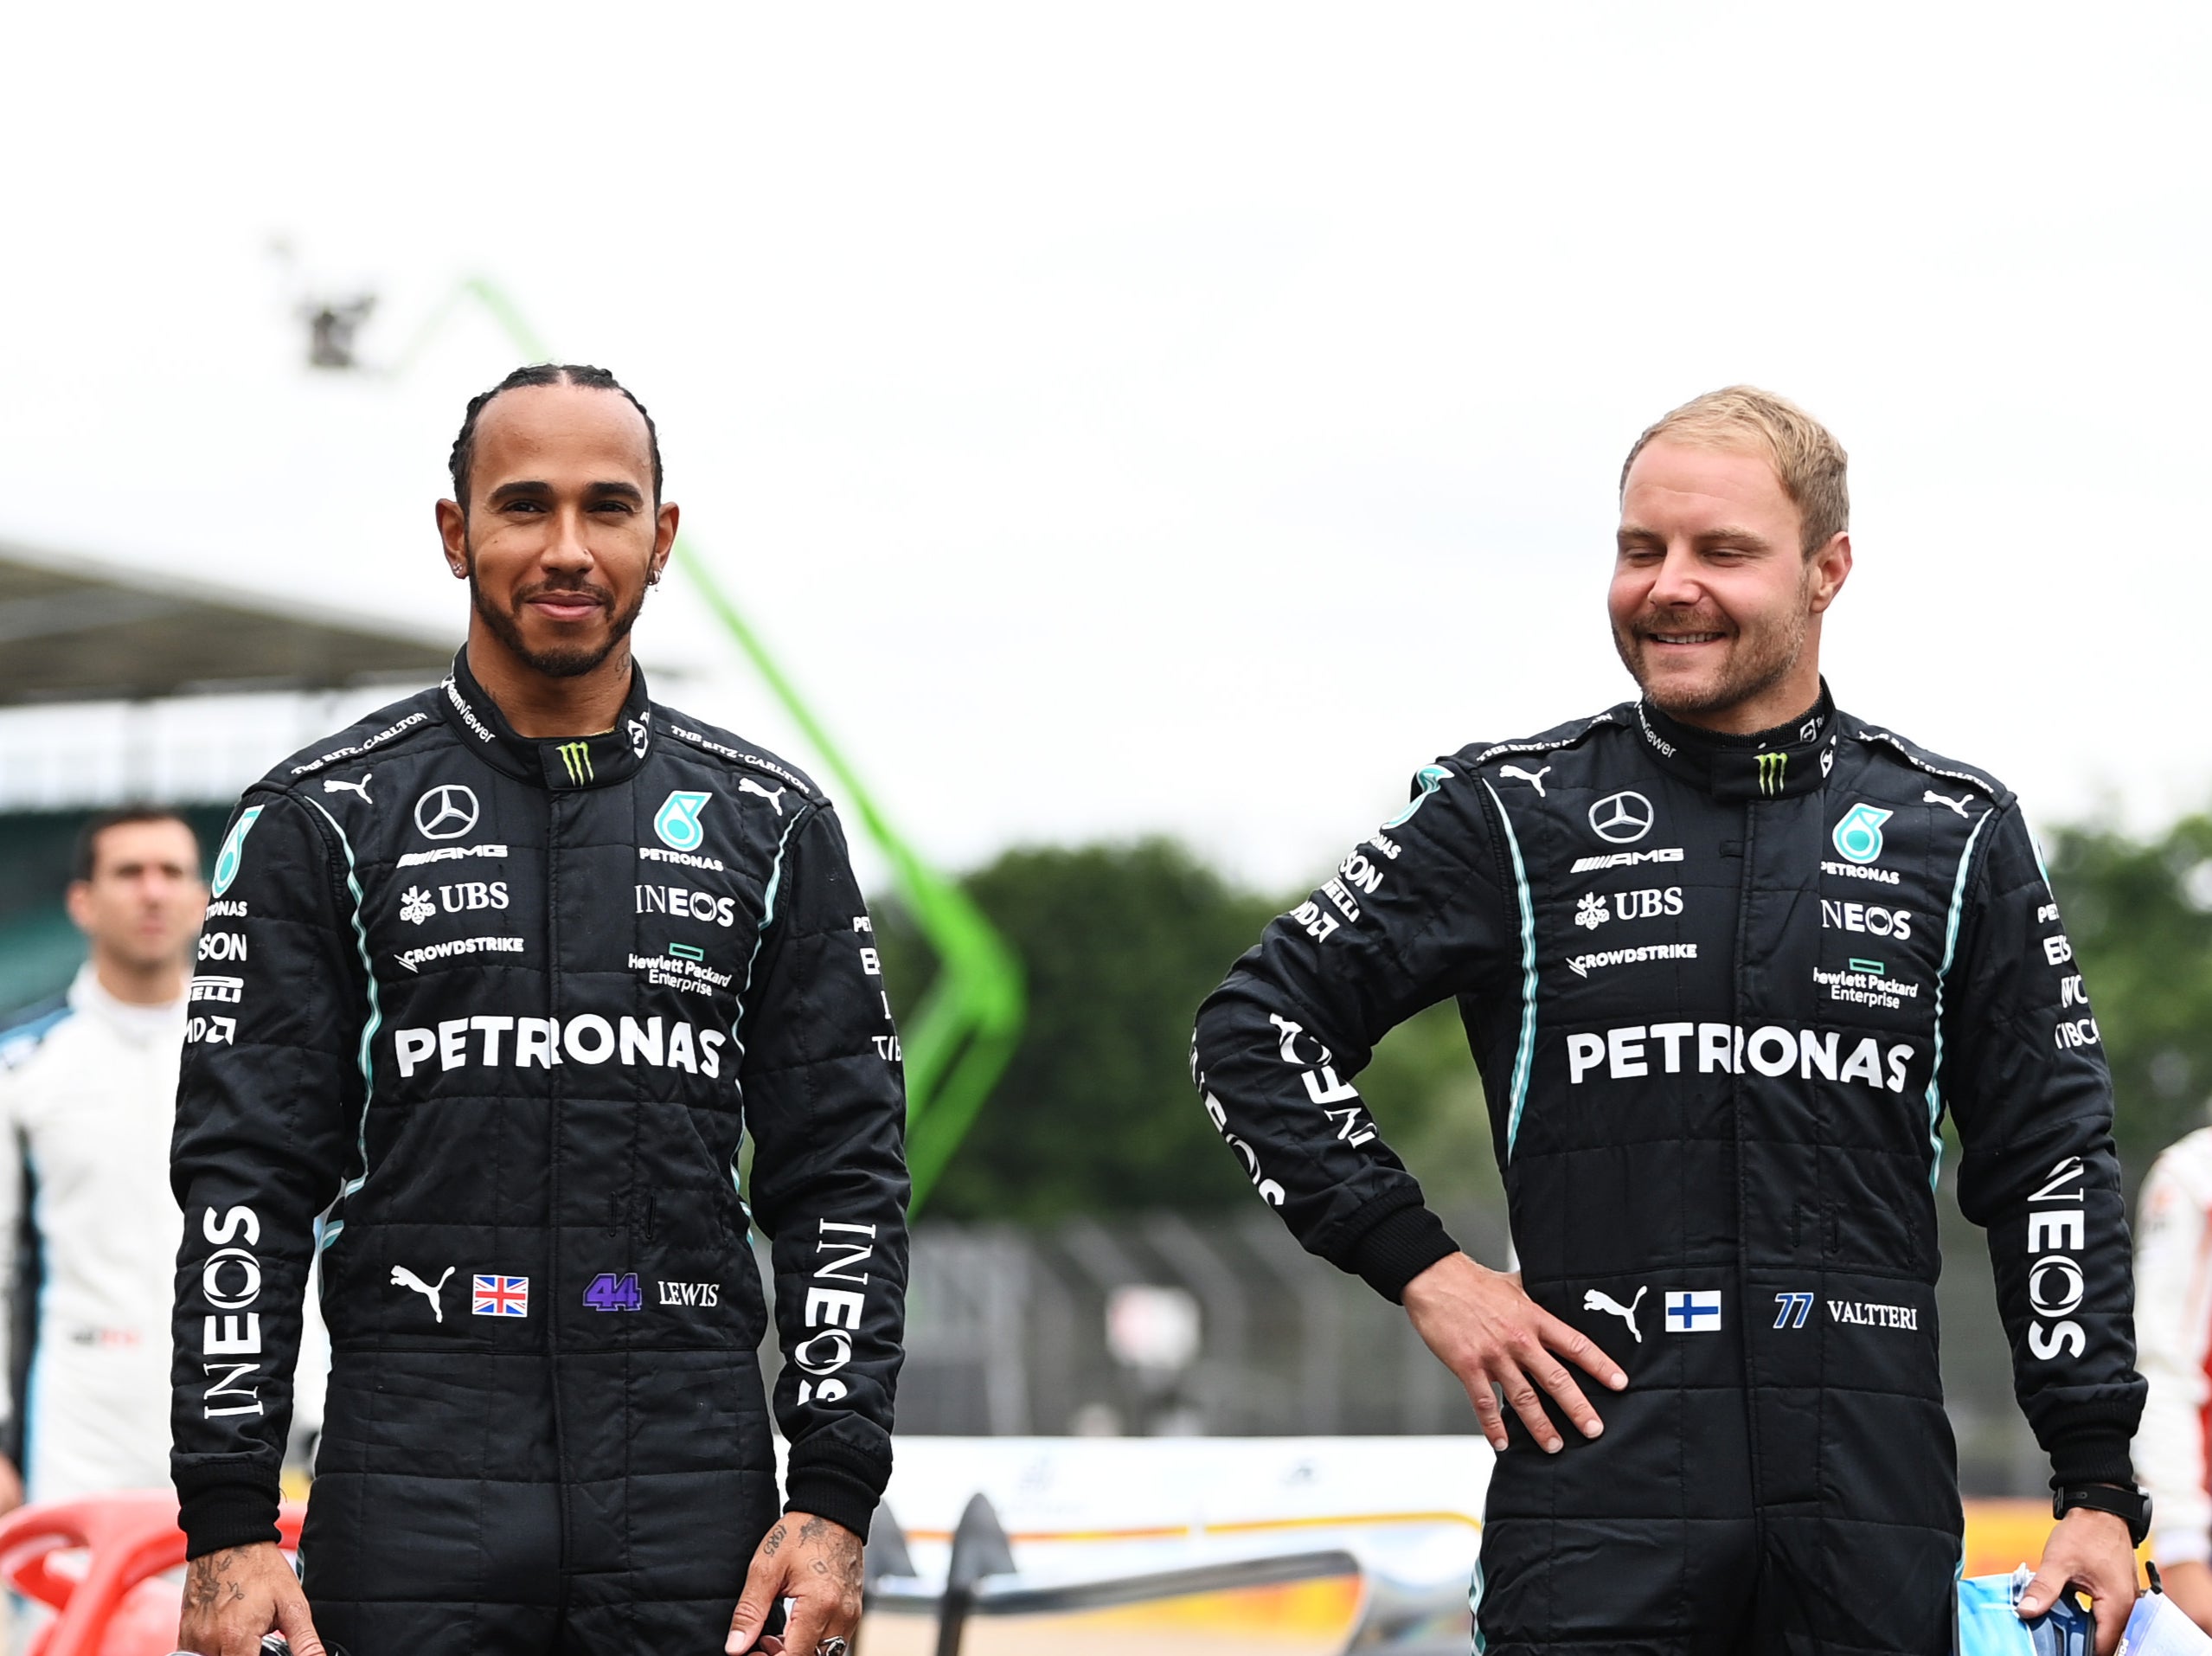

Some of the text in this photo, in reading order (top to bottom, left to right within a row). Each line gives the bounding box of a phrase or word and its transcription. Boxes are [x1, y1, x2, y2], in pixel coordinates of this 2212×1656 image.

[429, 844, 508, 863] AMG
[639, 848, 724, 871] PETRONAS
[1605, 848, 1684, 869] AMG
[1339, 850, 1384, 895] SON
[439, 882, 510, 913] UBS
[634, 884, 735, 927] INEOS
[1614, 887, 1684, 920] UBS
[1820, 899, 1912, 940] NEOS
[197, 932, 247, 961] SON
[403, 937, 524, 964] CROWDSTRIKE
[1574, 944, 1697, 969] CROWDSTRIKE
[628, 953, 733, 988] Hewlett Packard
[649, 969, 713, 997] Enterprise
[1869, 974, 1919, 998] Packard
[1831, 985, 1900, 1010] Enterprise
[394, 1013, 727, 1079] PETRONAS
[1567, 1022, 1915, 1094] PETRONAS
[2027, 1156, 2086, 1361] NEOS
[582, 1273, 720, 1312] 44 LEWIS
[202, 1205, 264, 1420] INEOS
[1773, 1292, 1919, 1332] 77 VALTTERI
